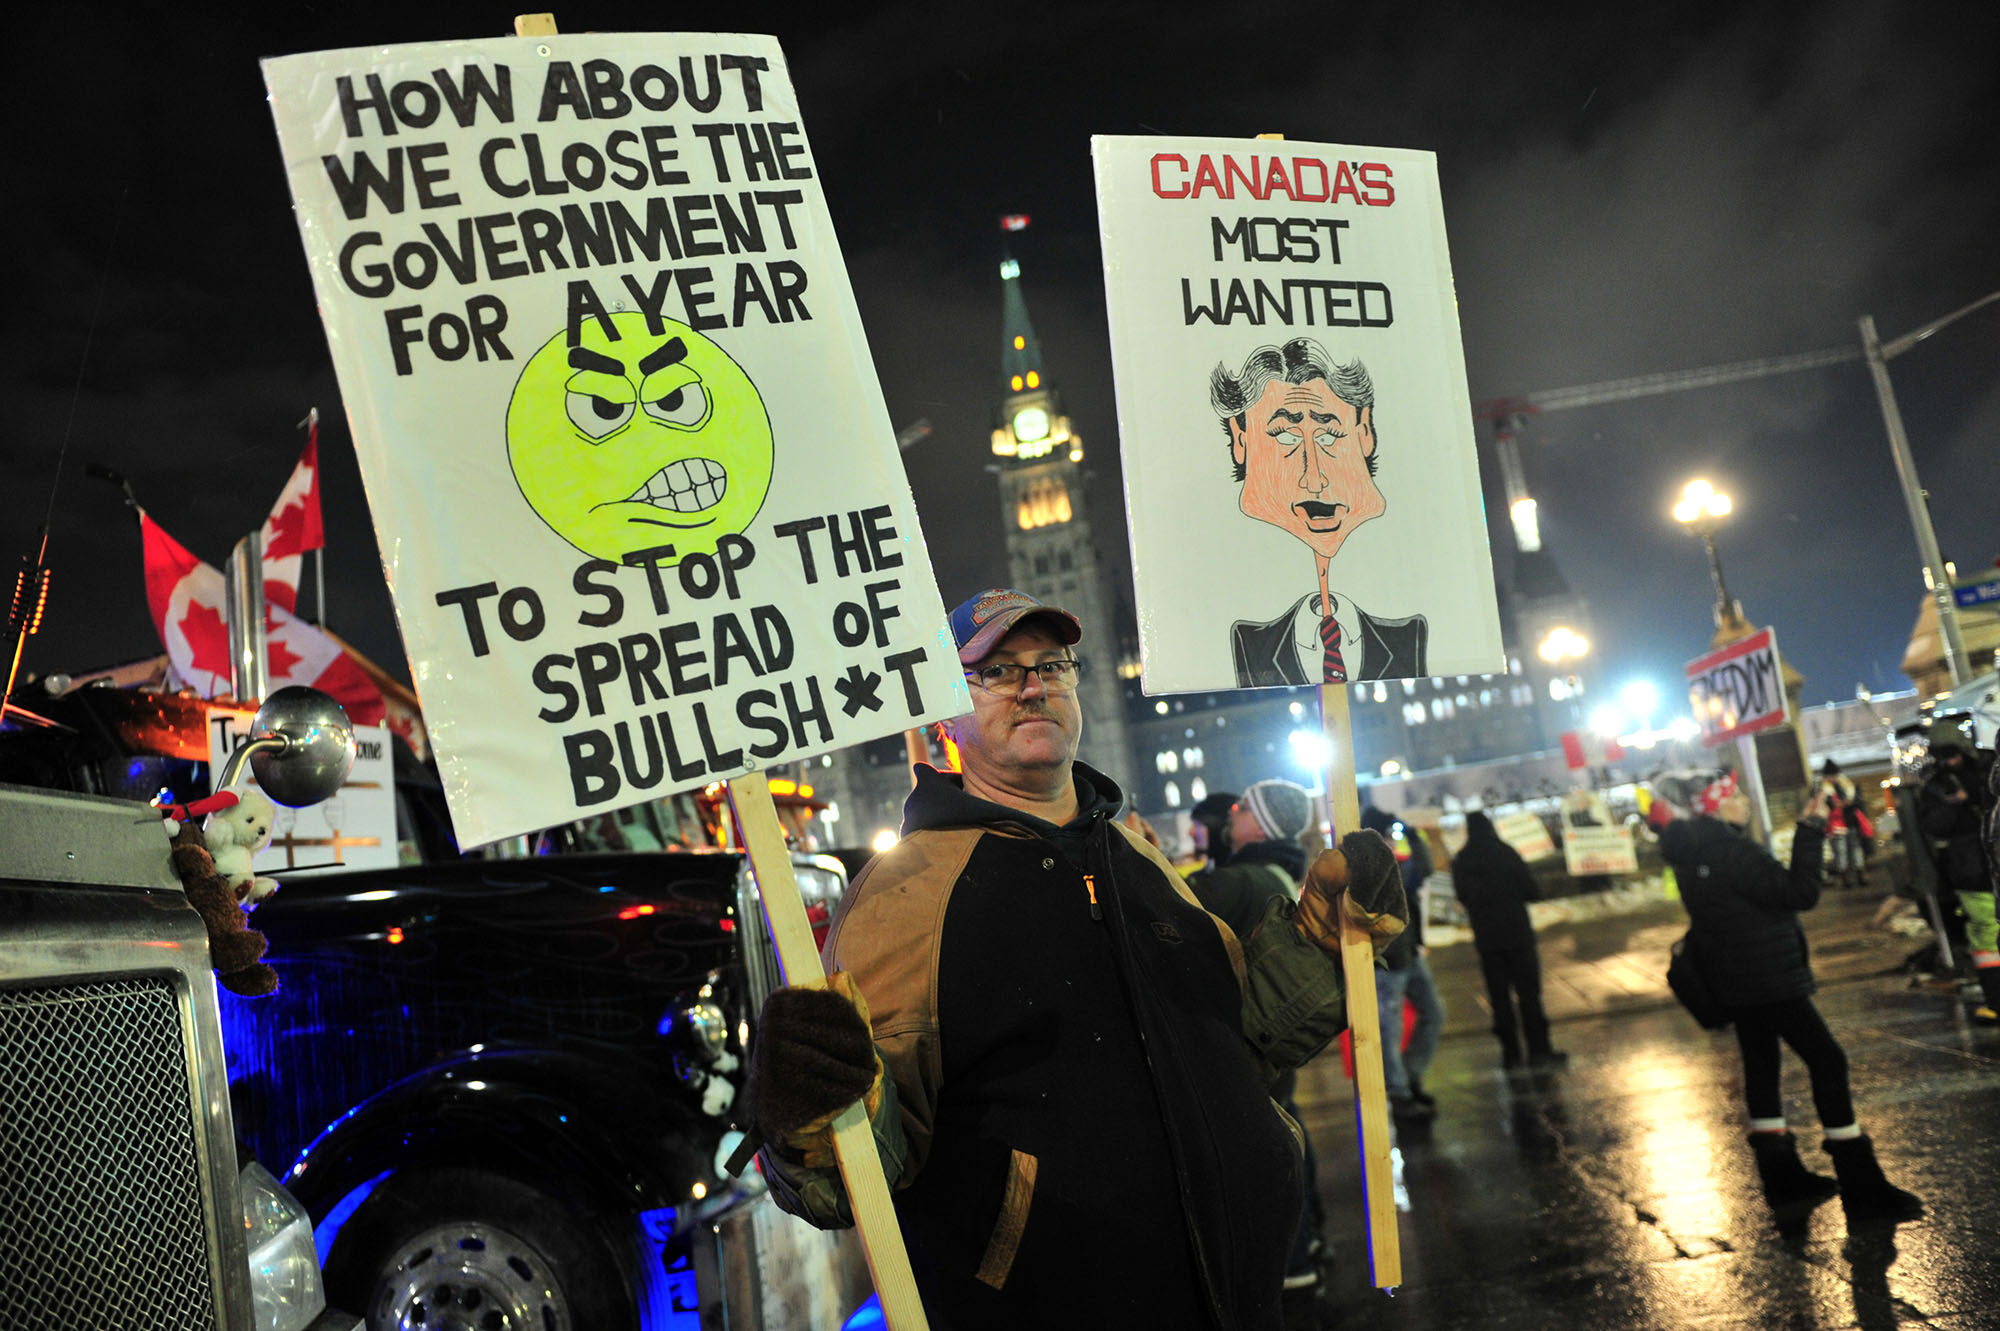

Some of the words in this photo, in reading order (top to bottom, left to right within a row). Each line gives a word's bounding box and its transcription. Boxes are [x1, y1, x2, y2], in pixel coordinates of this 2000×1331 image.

[336, 63, 514, 138] HOW
[537, 54, 769, 122] ABOUT
[321, 142, 461, 220] WE
[479, 125, 690, 199] CLOSE
[693, 121, 813, 183] THE
[1150, 153, 1396, 207] CANADA'S
[338, 189, 804, 298] GOVERNMENT
[1211, 216, 1350, 265] MOST
[384, 294, 514, 376] FOR
[566, 280, 622, 347] A
[621, 259, 813, 336] YEAR
[1181, 277, 1394, 329] WANTED
[435, 581, 546, 657] TO
[573, 533, 756, 628] STOP
[774, 504, 904, 585] THE
[531, 604, 795, 724] SPREAD
[833, 579, 902, 648] OF
